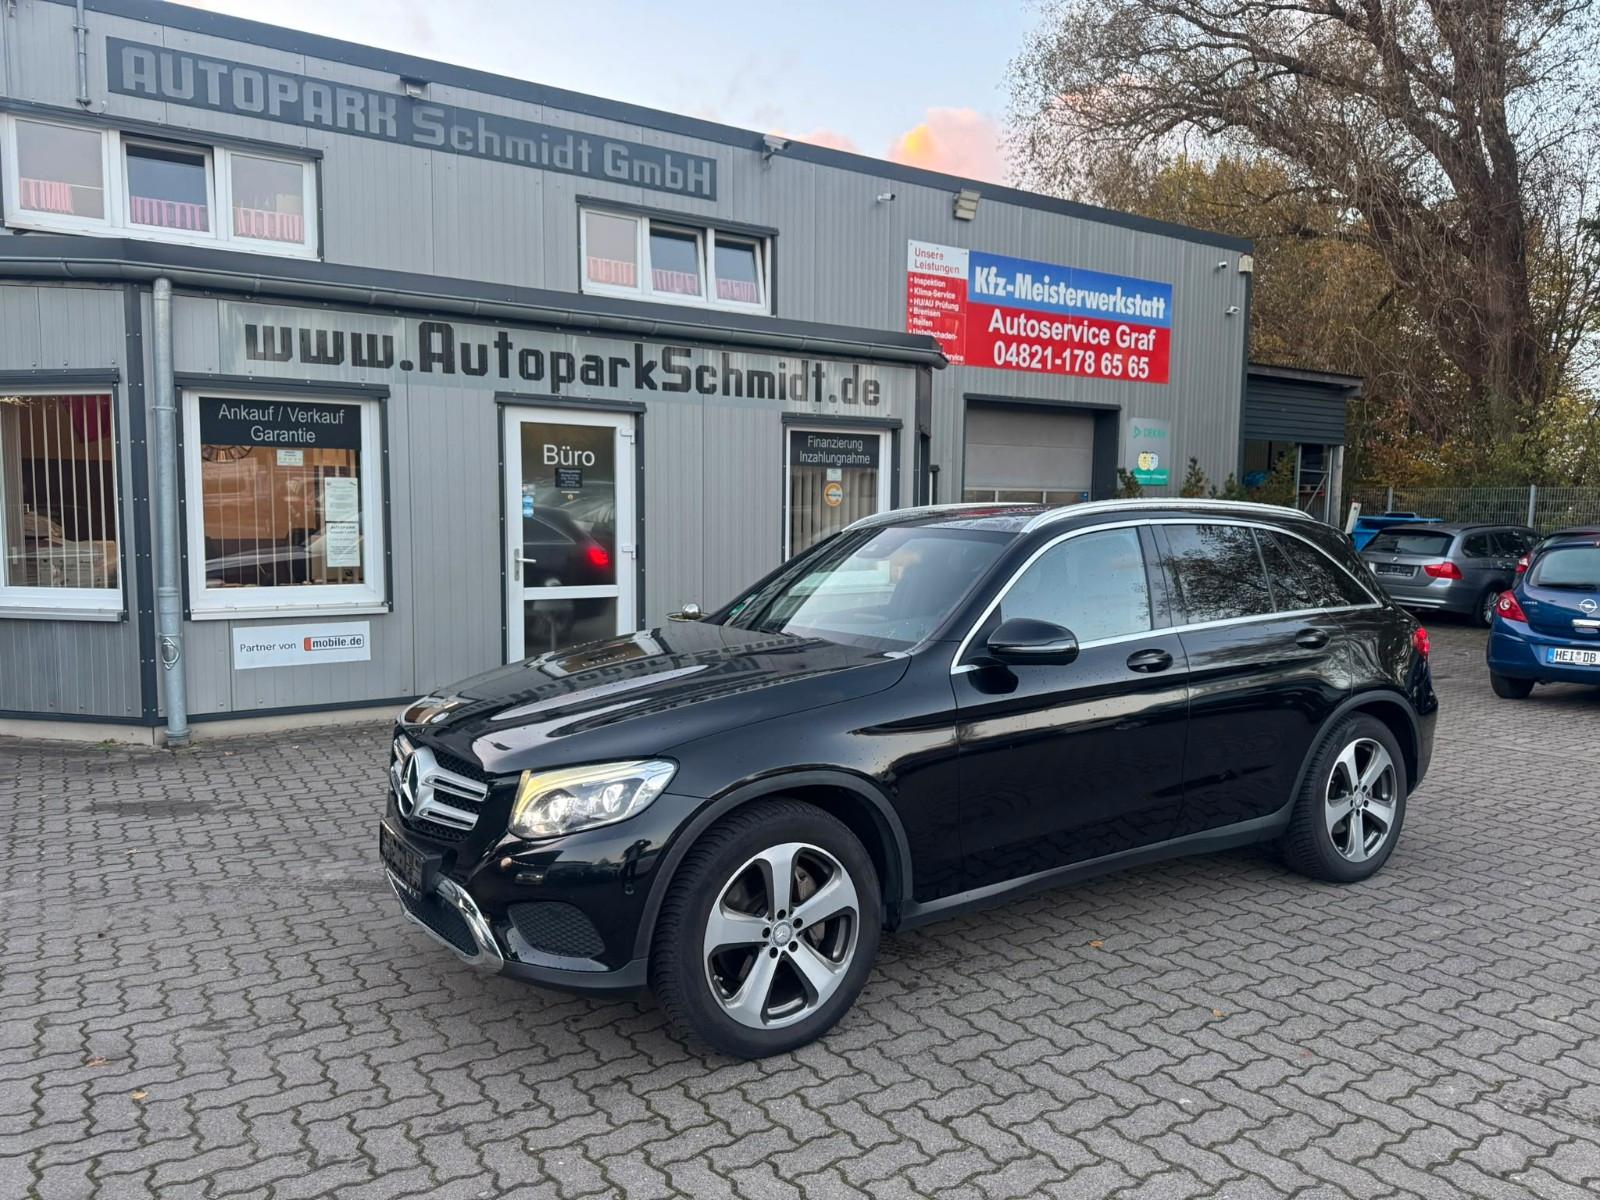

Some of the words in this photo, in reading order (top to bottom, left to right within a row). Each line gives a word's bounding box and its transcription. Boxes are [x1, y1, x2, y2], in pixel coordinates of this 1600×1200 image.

[121, 46, 397, 137] AUTOPARK
[412, 105, 592, 172] Schmidt
[604, 141, 710, 195] GmbH
[914, 247, 944, 260] Unsere
[914, 259, 960, 275] Leistungen
[914, 276, 946, 288] Inspektion
[914, 287, 956, 300] Klima-Service
[975, 265, 1165, 319] Kfz-Meisterwerkstatt
[913, 307, 940, 318] Bremsen
[935, 300, 959, 312] Prüfung
[913, 317, 933, 328] Reifen
[988, 308, 1110, 346] Autoservice
[1115, 325, 1156, 351] Graf
[244, 321, 880, 406] www.AutoparkSchmidt.de
[993, 340, 1096, 374] 04821-178
[1100, 352, 1122, 376] 65
[1127, 355, 1149, 379] 65
[218, 403, 275, 422] Ankauf
[287, 407, 345, 425] Verkauf
[250, 425, 316, 443] Garantie
[807, 435, 863, 452] Finanzierung
[543, 444, 595, 466] Büro
[799, 450, 870, 466] Inzahlungnahme
[239, 642, 276, 653] Partner
[278, 641, 297, 650] von
[312, 636, 362, 648] mobile.de
[1555, 650, 1574, 662] HEI
[1583, 651, 1597, 663] DB
